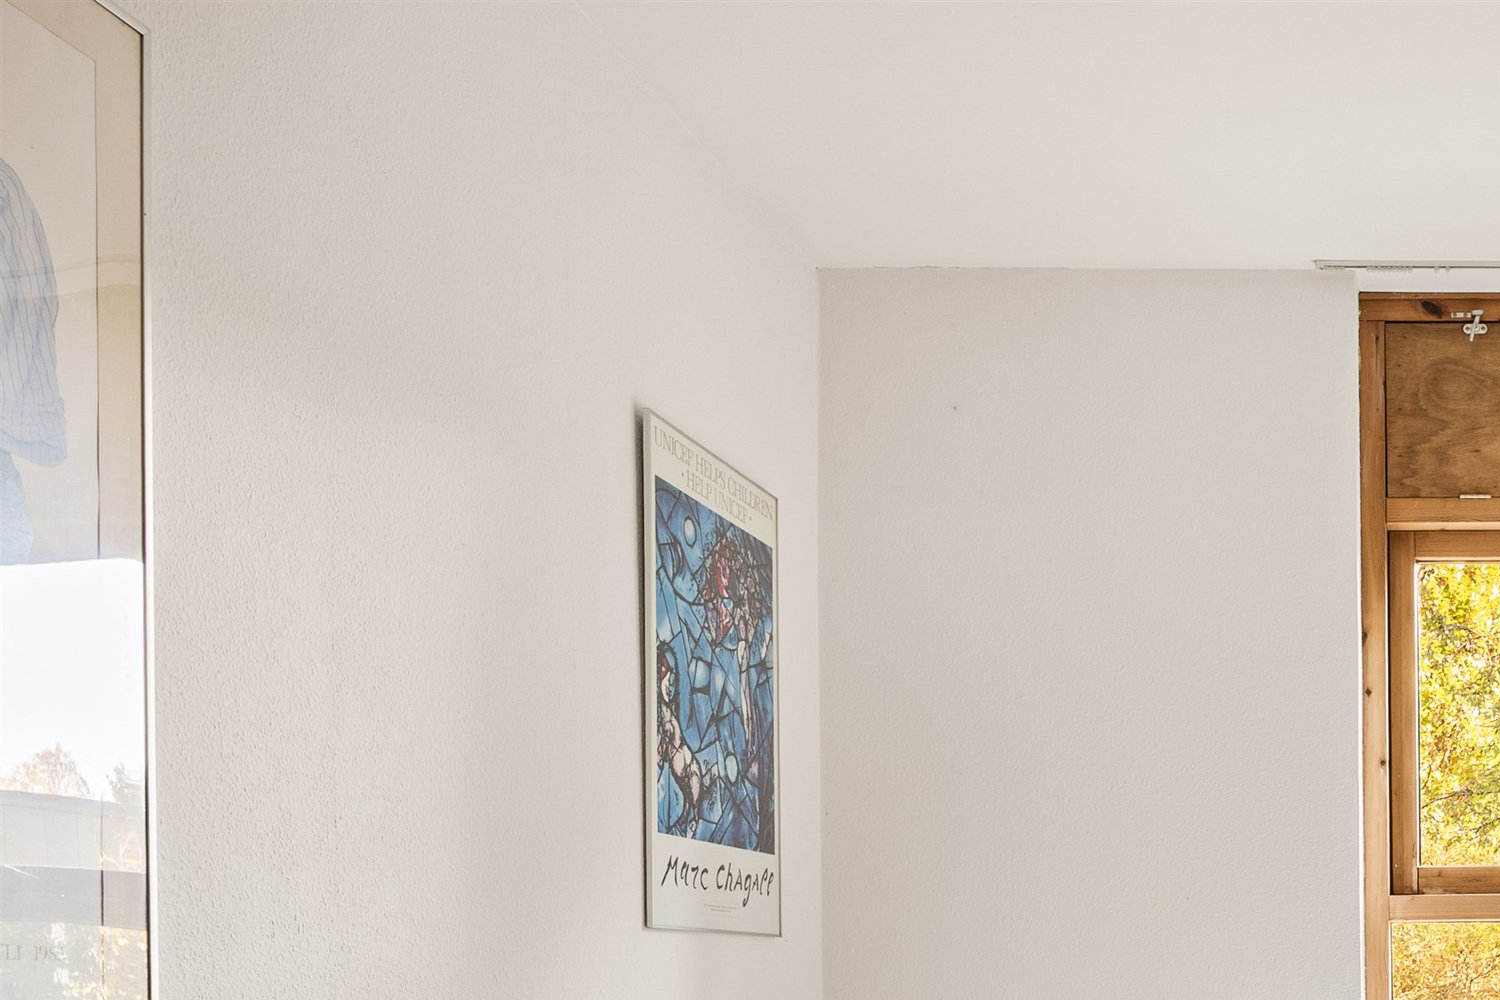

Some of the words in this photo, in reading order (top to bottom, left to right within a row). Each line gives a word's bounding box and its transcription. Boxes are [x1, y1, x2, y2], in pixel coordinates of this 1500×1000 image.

[654, 425, 694, 466] UNICEF
[696, 454, 726, 490] HELPS
[727, 477, 773, 521] CHILDREN
[686, 470, 712, 501] HELP
[714, 488, 748, 523] UNICEF
[661, 855, 709, 891] Marc
